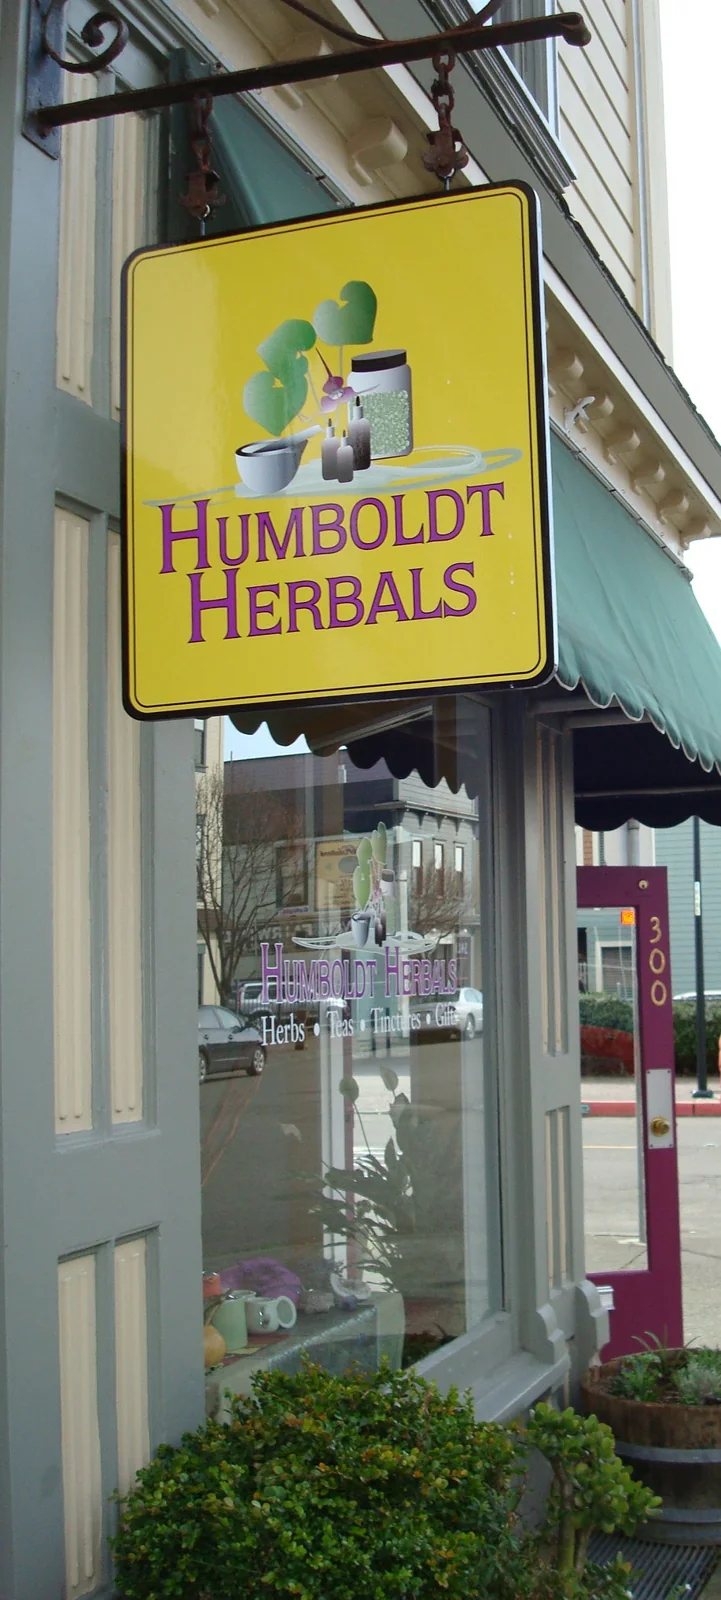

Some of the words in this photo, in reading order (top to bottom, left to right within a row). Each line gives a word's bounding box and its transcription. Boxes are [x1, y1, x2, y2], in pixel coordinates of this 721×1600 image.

[158, 482, 505, 574] HUMBOLDT
[187, 562, 477, 643] HERBALS
[260, 943, 377, 1004] HUMBOLDT
[384, 946, 457, 998] HERBALS
[649, 917, 667, 1006] 300
[261, 1013, 305, 1046] Herbs
[326, 1011, 354, 1038] Teas
[370, 1007, 421, 1033] Tinctures
